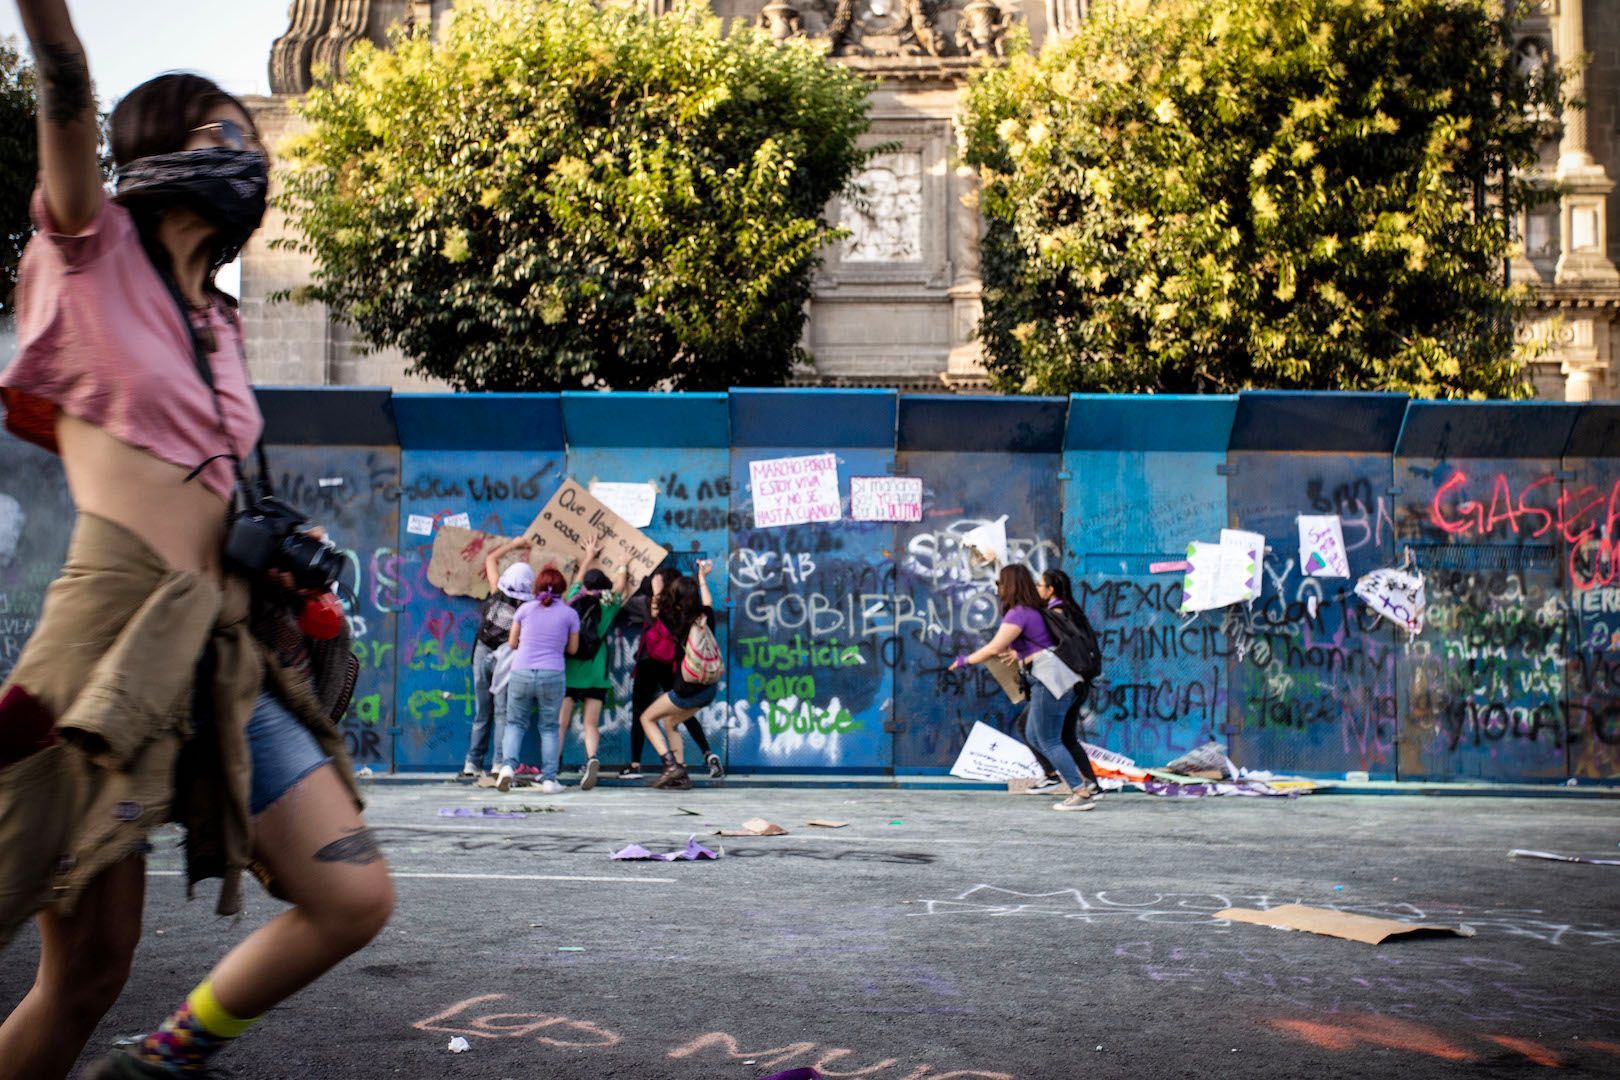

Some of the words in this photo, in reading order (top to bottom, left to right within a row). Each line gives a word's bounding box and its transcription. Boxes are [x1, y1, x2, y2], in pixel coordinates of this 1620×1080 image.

[753, 461, 801, 479] MARCHO
[804, 457, 834, 475] PORQUE
[760, 480, 791, 496] ESTOY
[796, 475, 820, 489] VIVA
[788, 493, 801, 504] NO
[558, 488, 586, 516] Que
[588, 509, 618, 541] llegar
[758, 508, 794, 526] HASTA
[796, 502, 839, 521] CUANDO
[531, 533, 546, 547] no
[553, 520, 580, 543] casa
[1081, 579, 1184, 621] MEXIC
[745, 591, 999, 642] GOBIERNO
